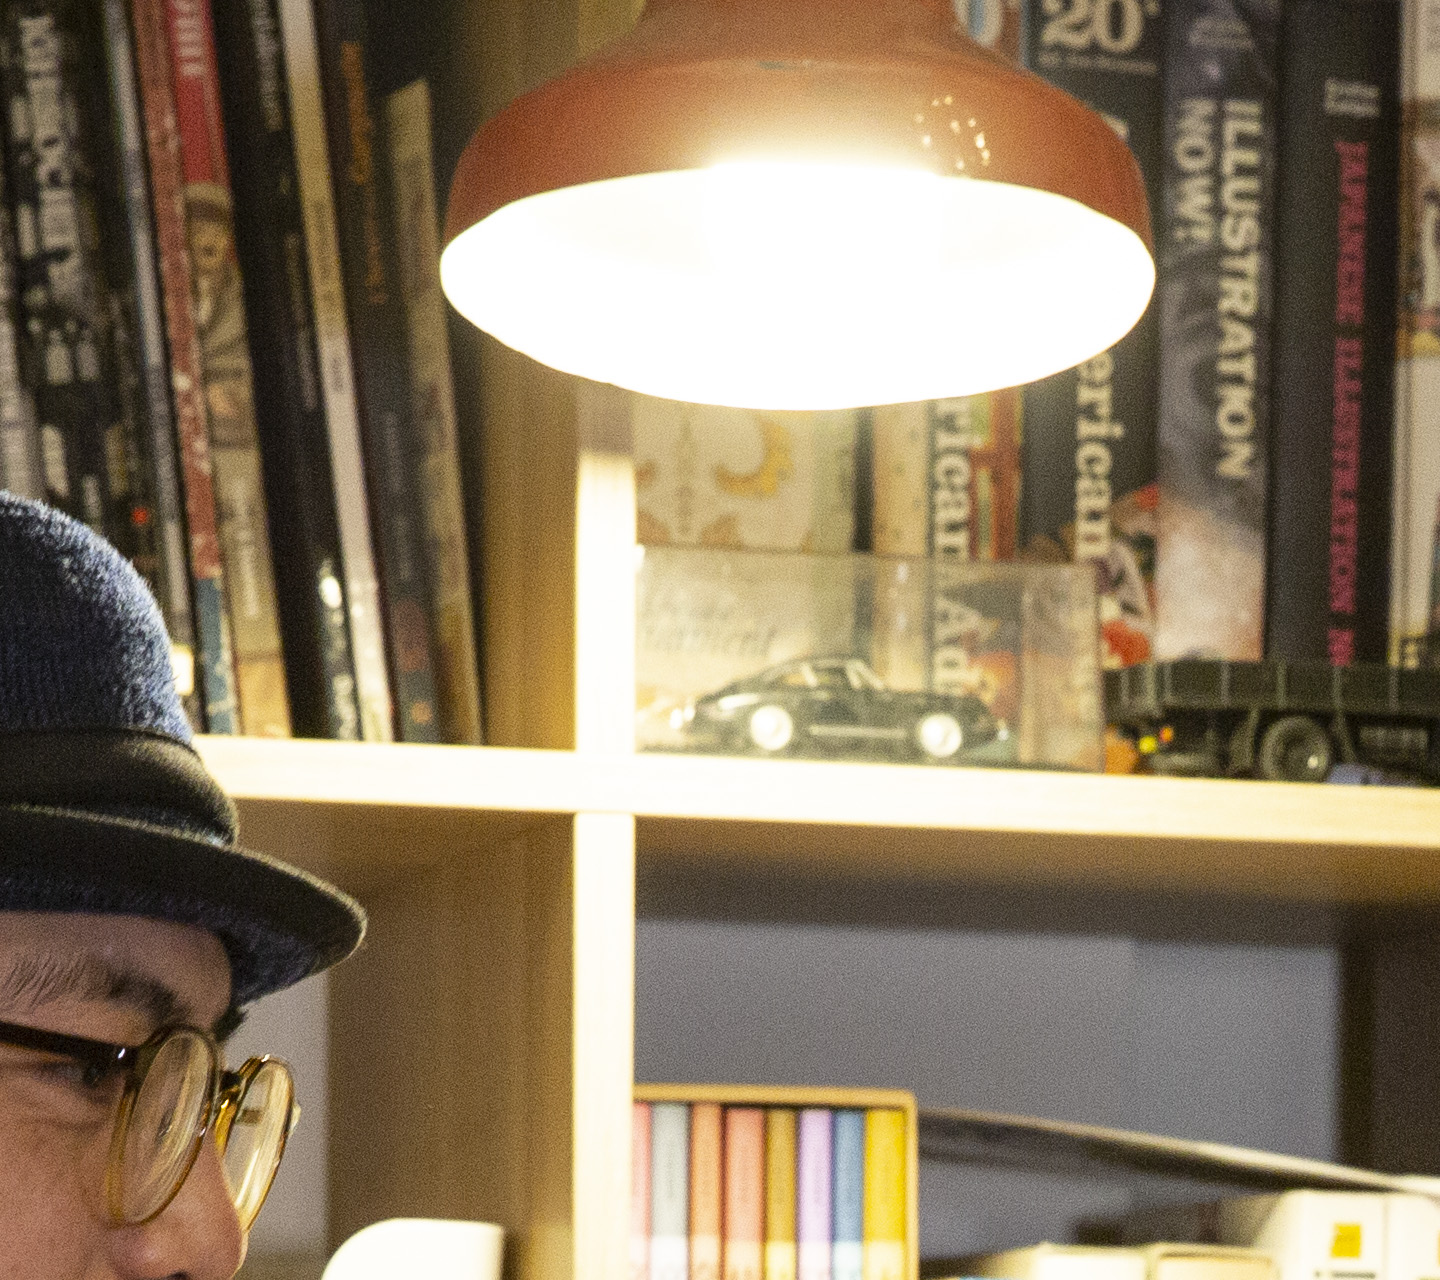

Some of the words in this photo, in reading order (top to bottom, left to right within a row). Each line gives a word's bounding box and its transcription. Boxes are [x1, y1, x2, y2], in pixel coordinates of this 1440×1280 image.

[1041, 0, 1159, 52] 20
[1173, 102, 1214, 245] NOW!
[1334, 140, 1369, 325] JAPANESE
[1215, 101, 1261, 482] ILLUSTRATION
[1075, 351, 1125, 558] erican
[1329, 336, 1363, 614] ILLUSTRATION
